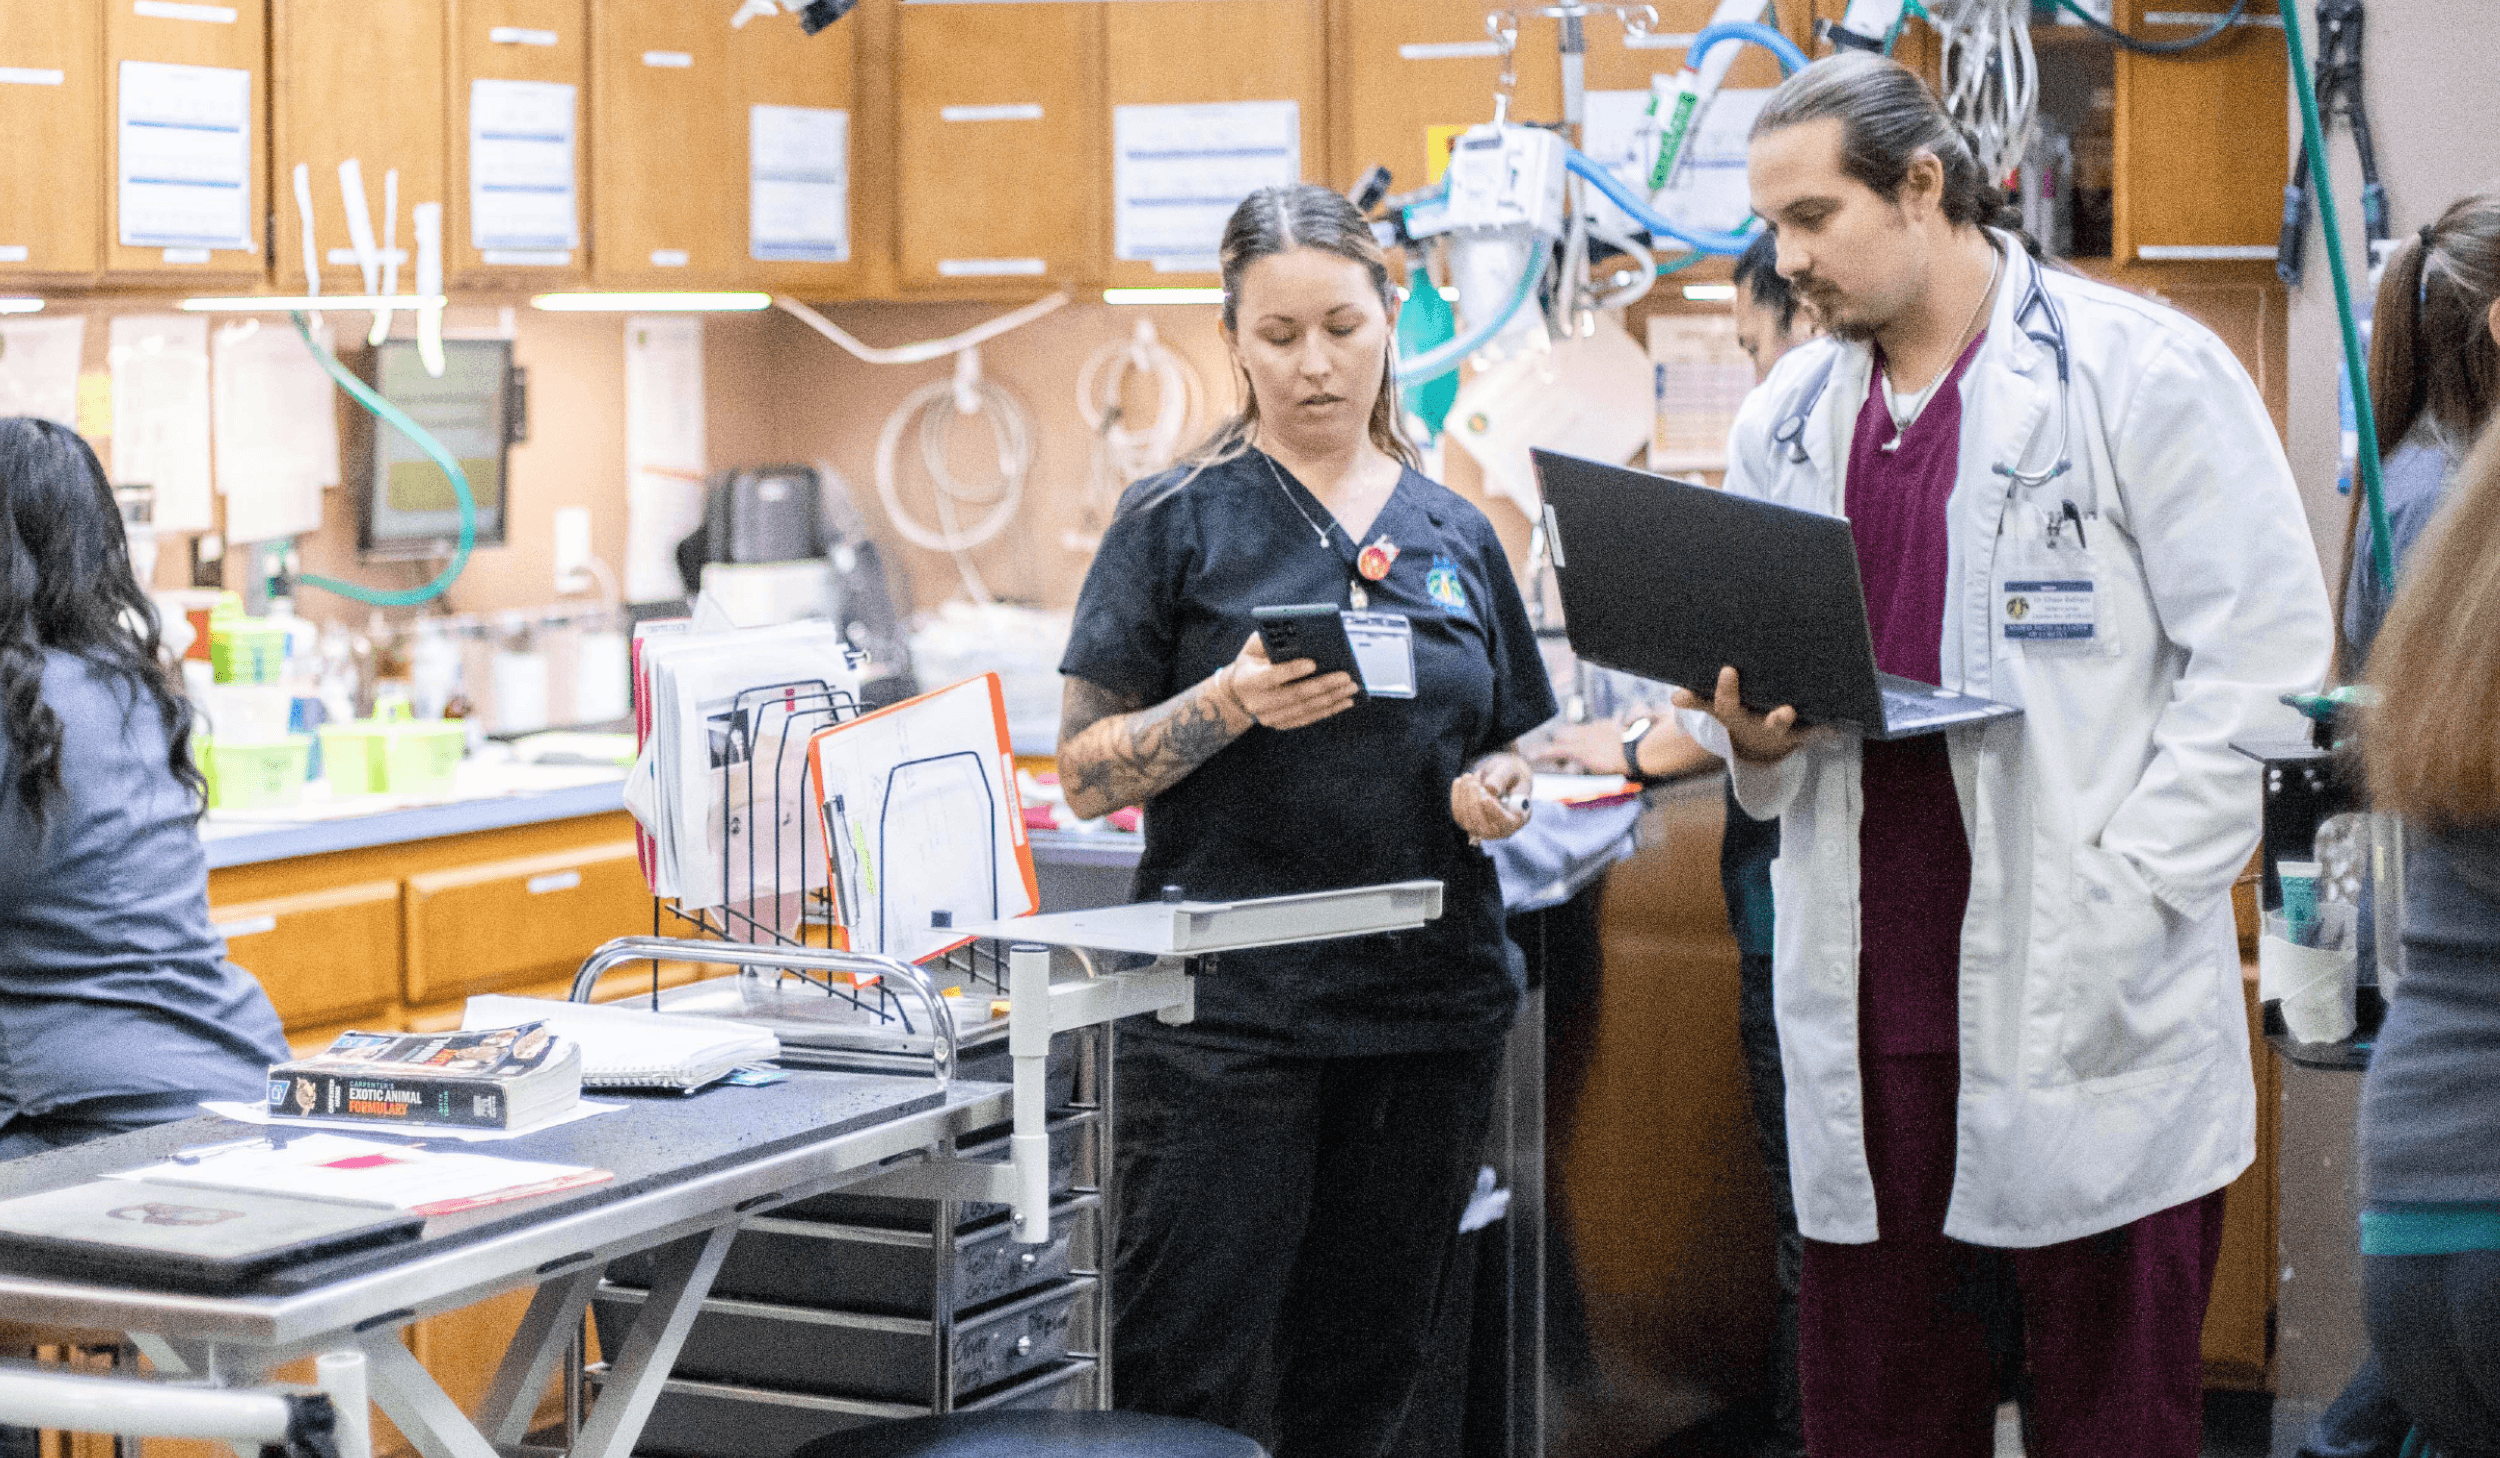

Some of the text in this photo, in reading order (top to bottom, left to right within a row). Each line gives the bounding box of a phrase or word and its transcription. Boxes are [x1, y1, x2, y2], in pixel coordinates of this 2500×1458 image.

[349, 1081, 395, 1090] CARPENTER'S
[349, 1087, 423, 1104] EXOTIC ANIMAL
[349, 1101, 408, 1116] FORMULARY
